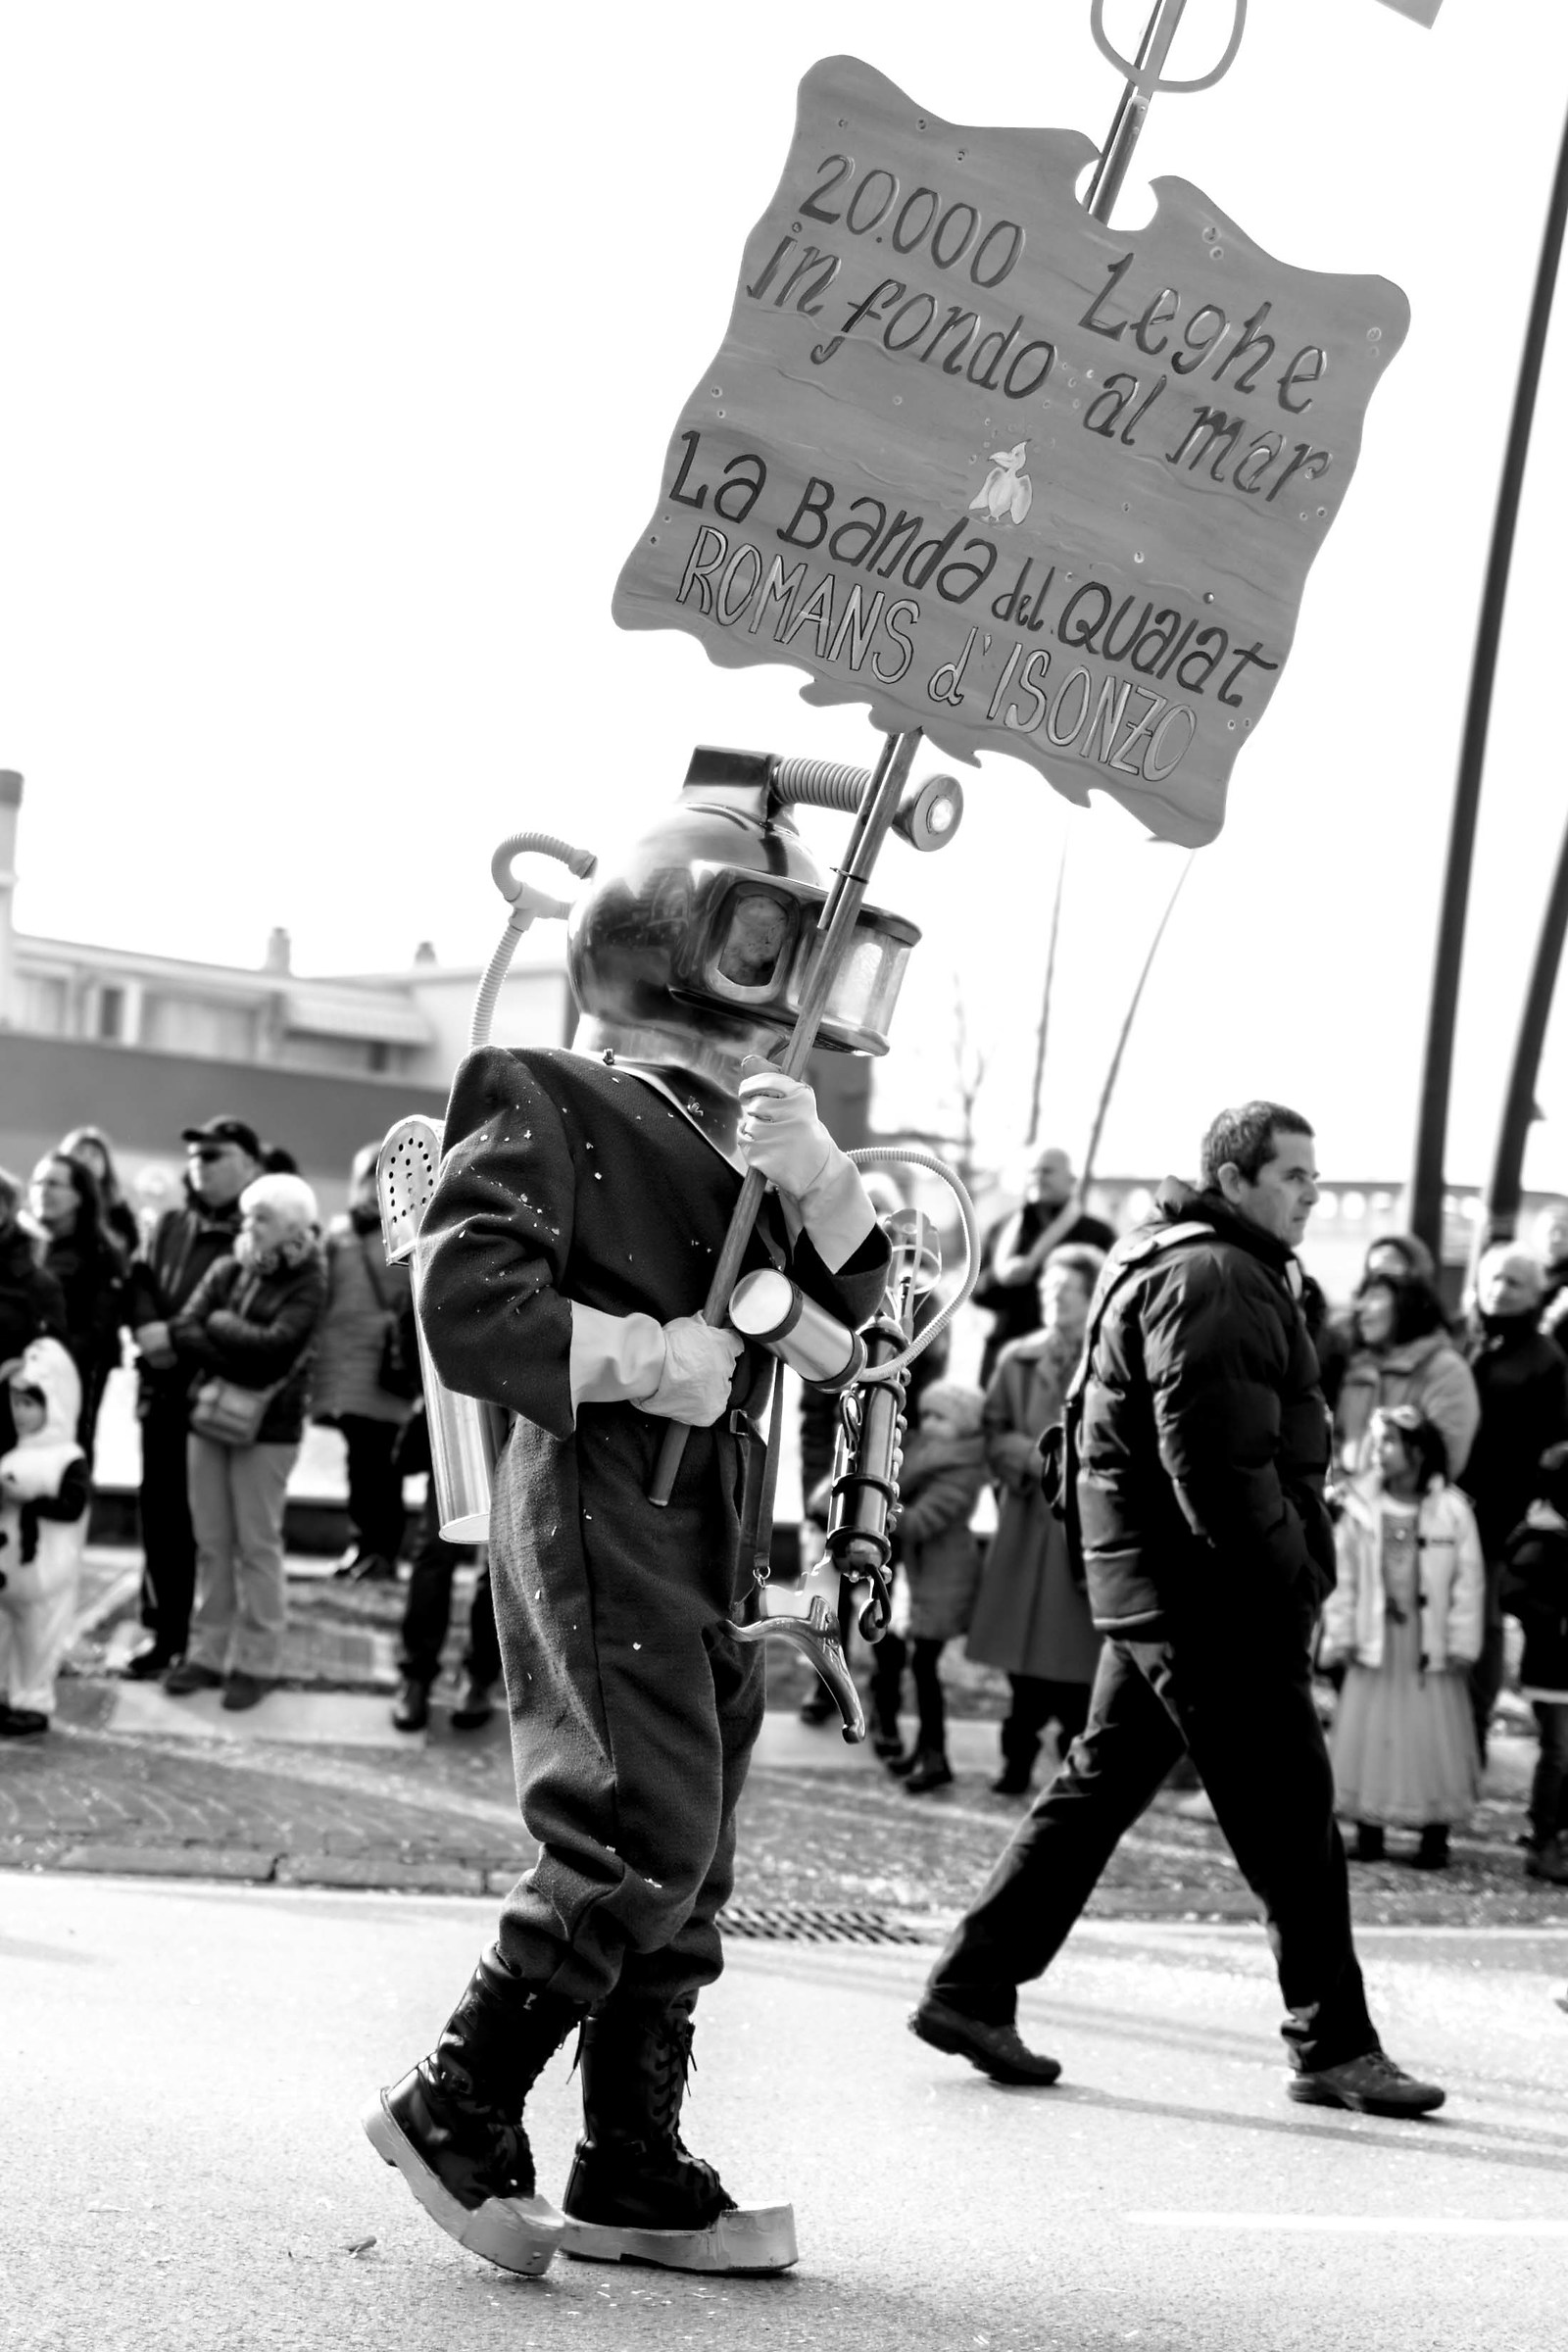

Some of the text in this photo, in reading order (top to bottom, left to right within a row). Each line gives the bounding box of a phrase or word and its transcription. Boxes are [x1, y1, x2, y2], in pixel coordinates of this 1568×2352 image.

[746, 221, 1332, 502] in fondo al mar
[799, 154, 1327, 415] 20.000 Leghe
[668, 430, 766, 524] La
[776, 476, 998, 604] Banda
[676, 524, 920, 685] ROMANS
